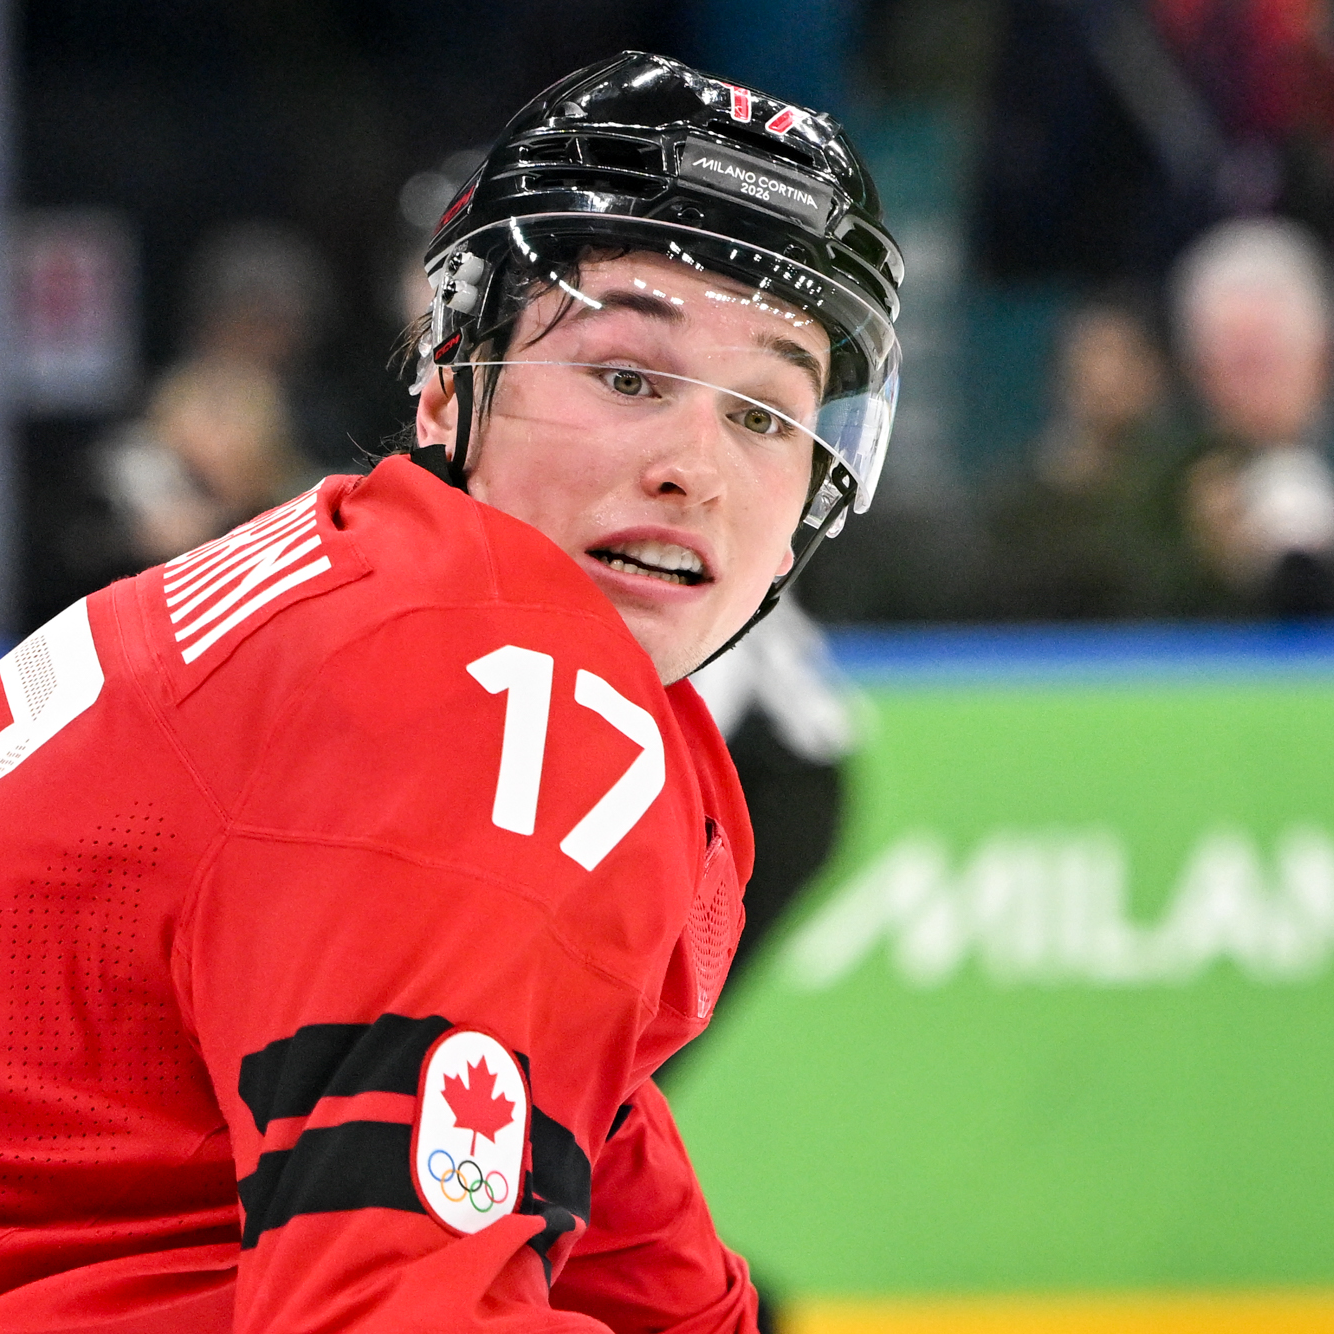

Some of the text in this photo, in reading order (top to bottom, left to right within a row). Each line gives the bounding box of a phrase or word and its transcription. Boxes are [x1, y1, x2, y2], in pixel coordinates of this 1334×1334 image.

[692, 157, 818, 209] MILANO CORTINA
[740, 182, 770, 201] 2026
[467, 644, 665, 872] 17
